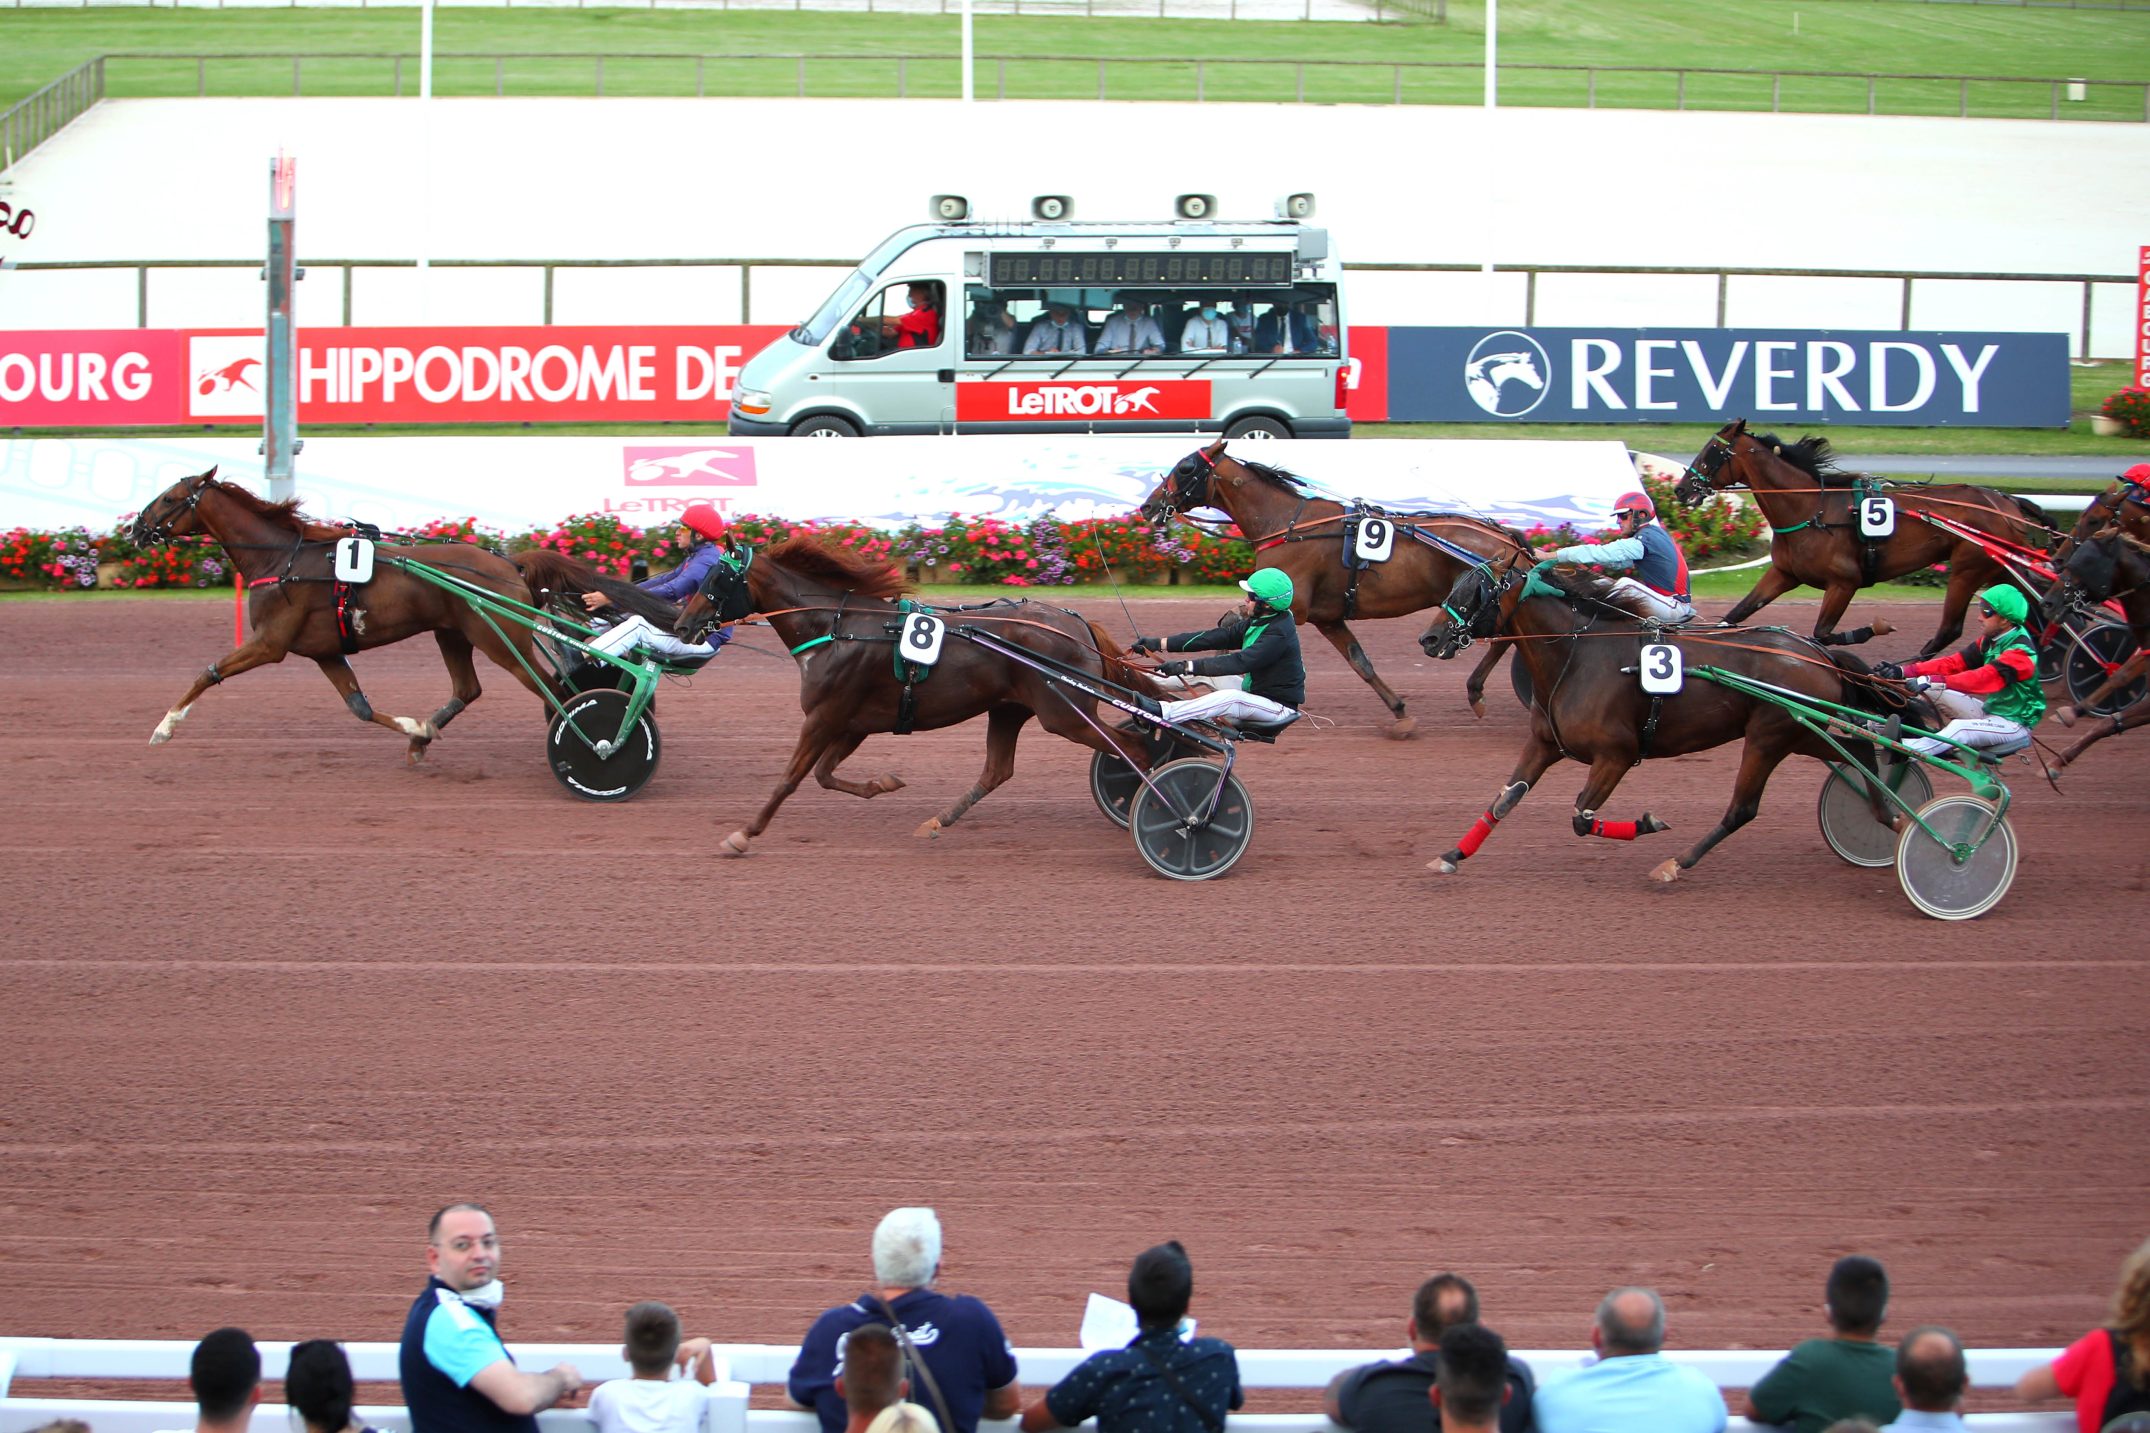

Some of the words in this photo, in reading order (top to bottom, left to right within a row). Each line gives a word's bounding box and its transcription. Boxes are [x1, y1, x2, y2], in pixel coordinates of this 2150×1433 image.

[0, 351, 153, 402] OURG
[300, 344, 657, 404] HIPPODROME
[676, 345, 743, 401] DE
[1571, 338, 2001, 414] REVERDY
[1008, 385, 1119, 415] LeTROT
[1867, 499, 1887, 526] 5
[1364, 520, 1386, 549] 9
[347, 539, 360, 570] 1
[536, 624, 568, 641] CUSTOM
[909, 616, 936, 650] 8
[1649, 645, 1674, 680] 3
[1112, 699, 1162, 723] CUSTOM
